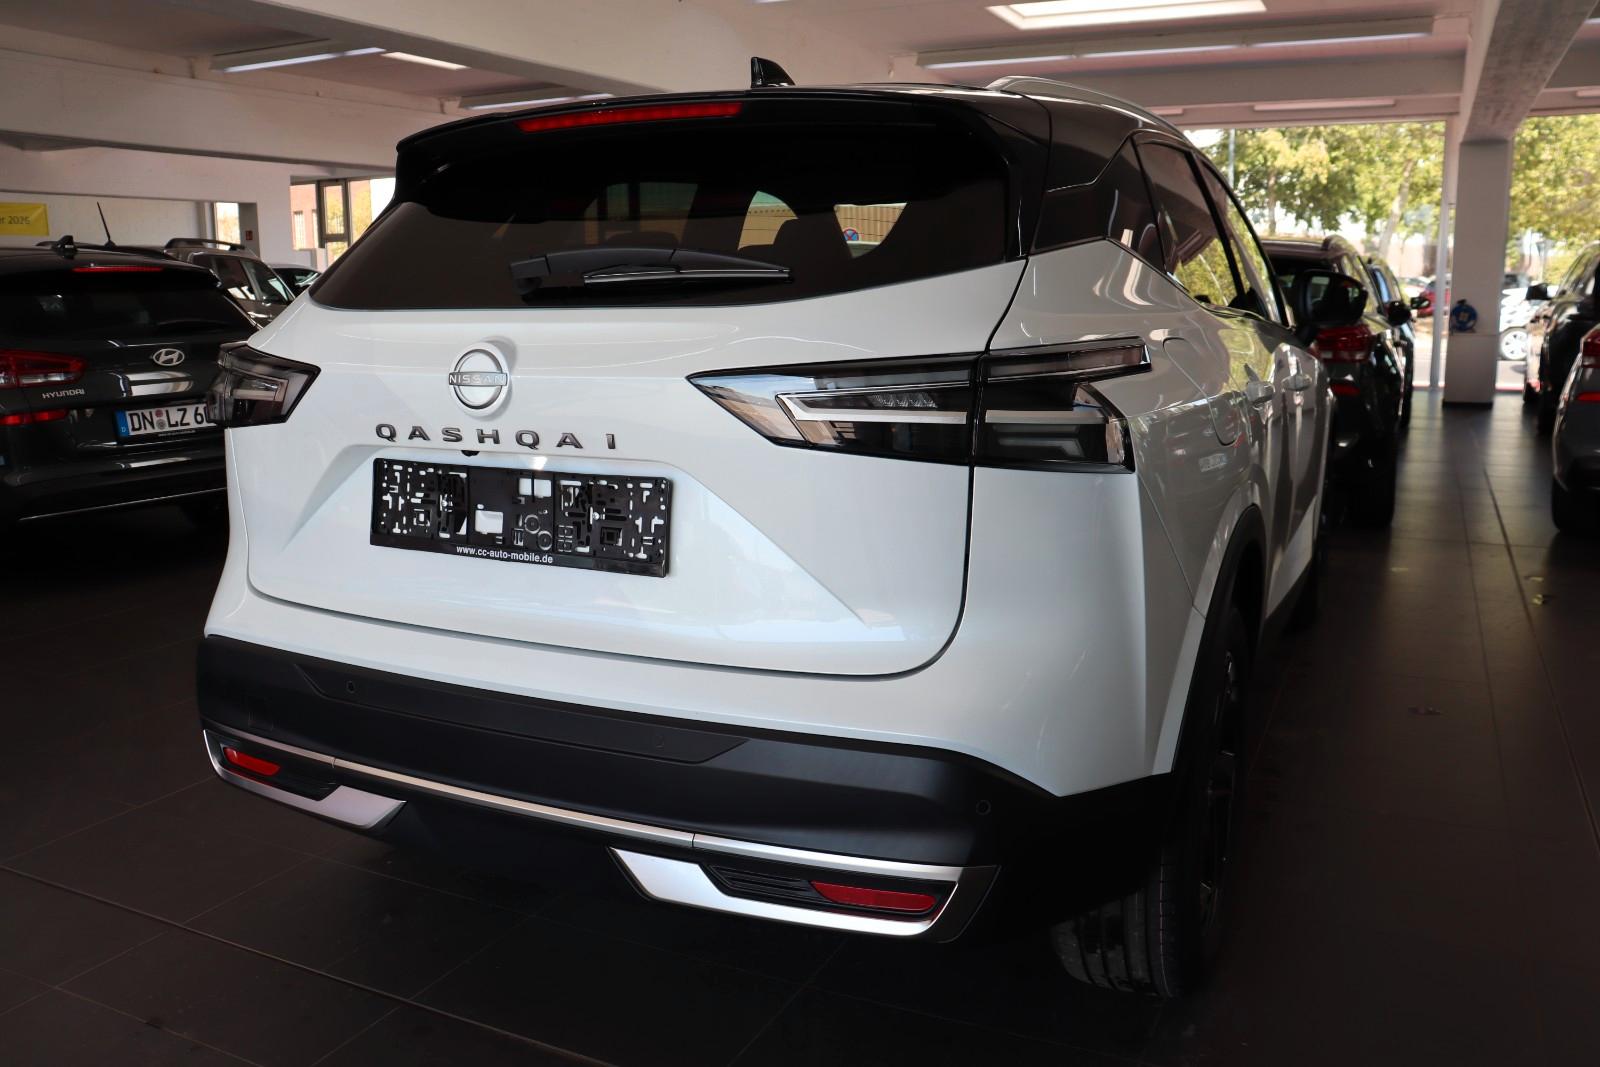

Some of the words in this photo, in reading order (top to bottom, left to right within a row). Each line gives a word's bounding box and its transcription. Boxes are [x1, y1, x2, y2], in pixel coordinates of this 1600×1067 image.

[449, 374, 505, 384] NISSAN
[42, 388, 85, 399] HYUNDAI
[128, 411, 155, 432] DN
[165, 407, 190, 428] LZ
[375, 423, 617, 450] QASHQAI
[456, 545, 554, 564] www.cc-auto-mobile.de
